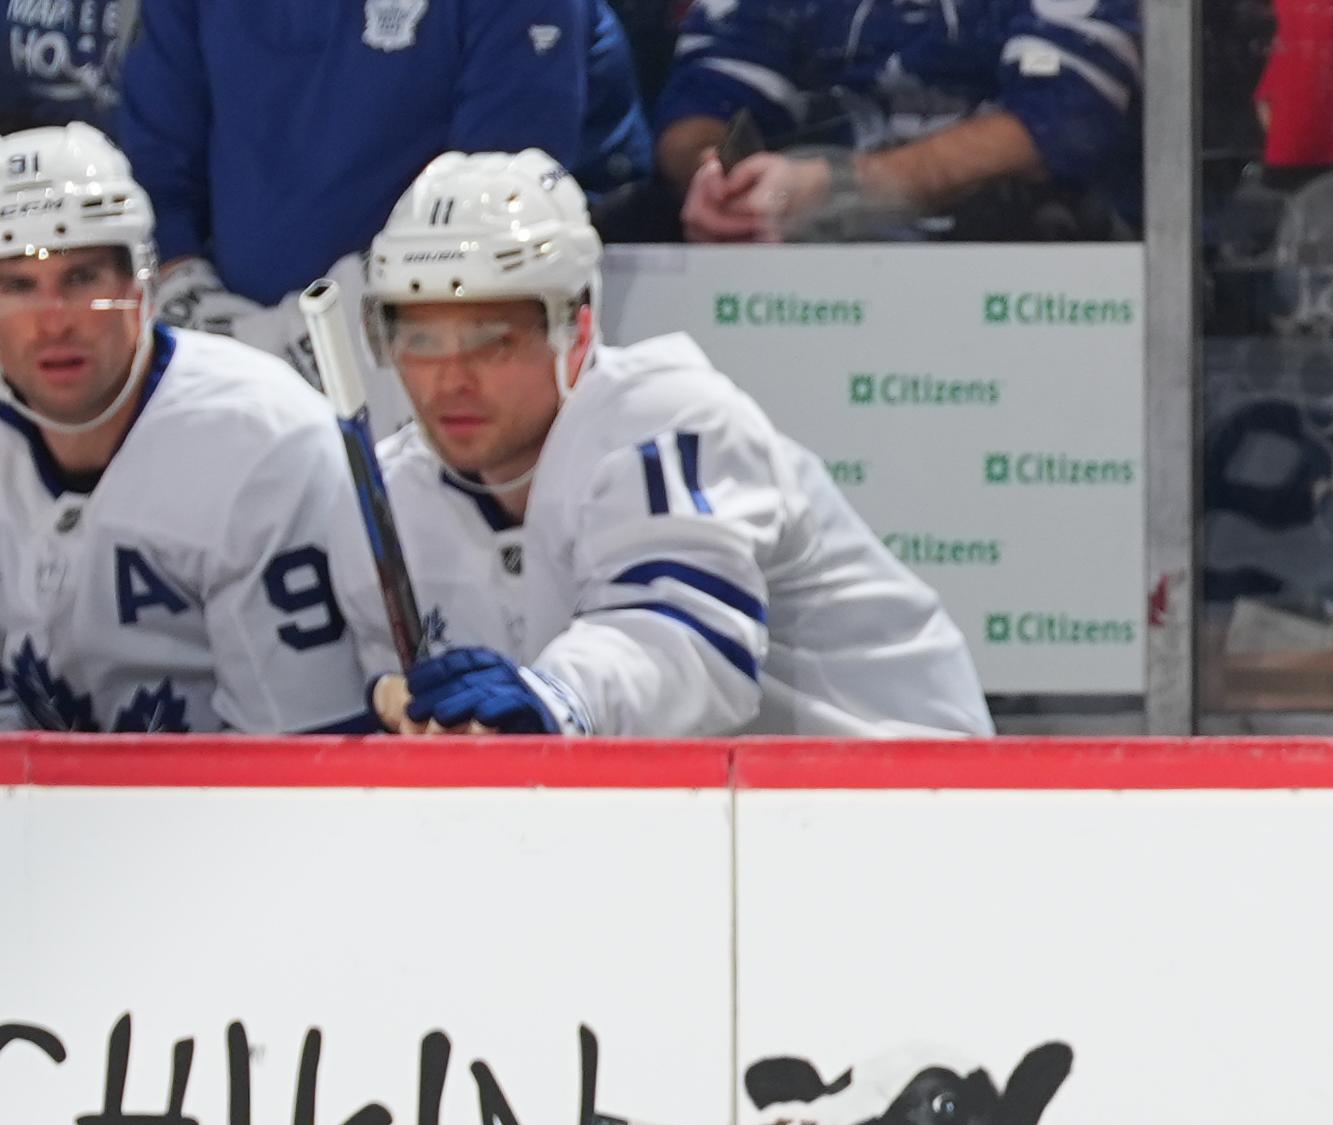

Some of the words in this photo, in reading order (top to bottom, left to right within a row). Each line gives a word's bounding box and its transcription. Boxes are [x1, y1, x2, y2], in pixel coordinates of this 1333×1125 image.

[430, 199, 454, 225] 11
[745, 293, 864, 325] Citizens
[1014, 292, 1135, 324] Citizens
[879, 374, 1000, 405] Citizens
[639, 431, 713, 517] 11
[1015, 452, 1135, 484] Citizens
[114, 545, 188, 625] A
[262, 543, 347, 650] 9
[1016, 612, 1136, 644] Citizens
